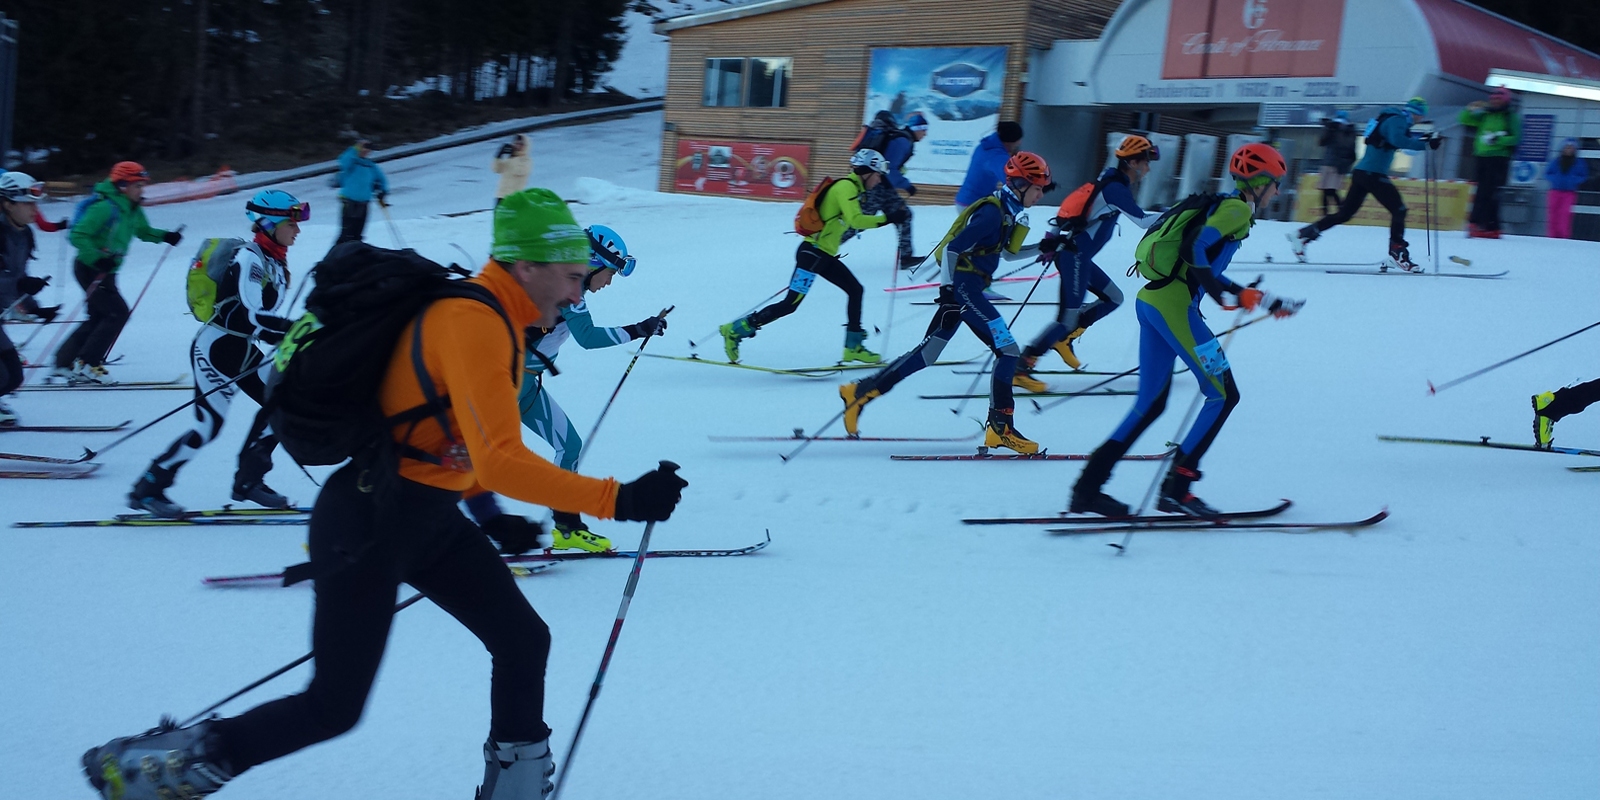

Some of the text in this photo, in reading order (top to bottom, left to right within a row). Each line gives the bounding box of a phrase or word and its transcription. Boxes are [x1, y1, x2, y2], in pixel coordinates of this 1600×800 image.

[1229, 37, 1252, 57] of
[1271, 85, 1287, 97] m
[1343, 85, 1358, 97] m
[195, 355, 236, 405] CRAZ
